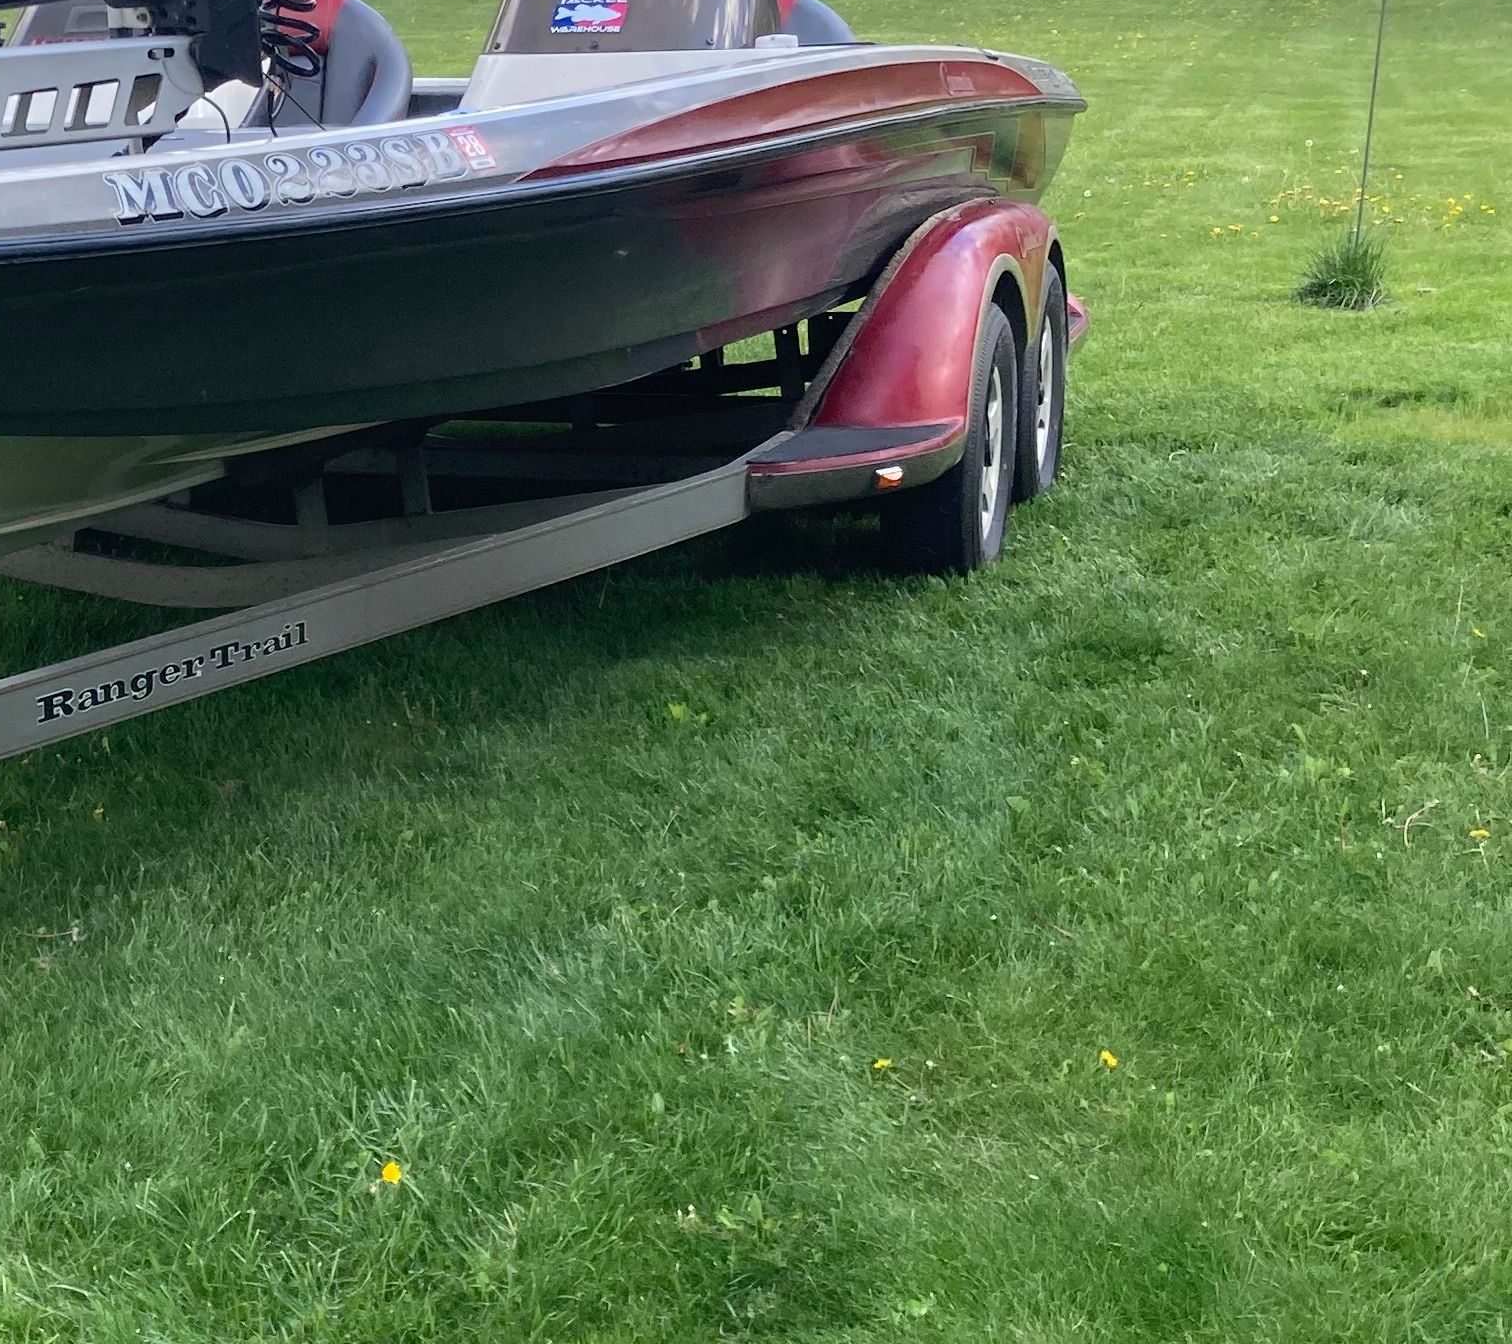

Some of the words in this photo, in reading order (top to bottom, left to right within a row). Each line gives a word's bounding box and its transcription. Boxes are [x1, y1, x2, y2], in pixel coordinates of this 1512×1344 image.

[550, 25, 621, 34] WAREHOUSE
[36, 654, 205, 727] Ranger
[210, 620, 310, 670] Trail
